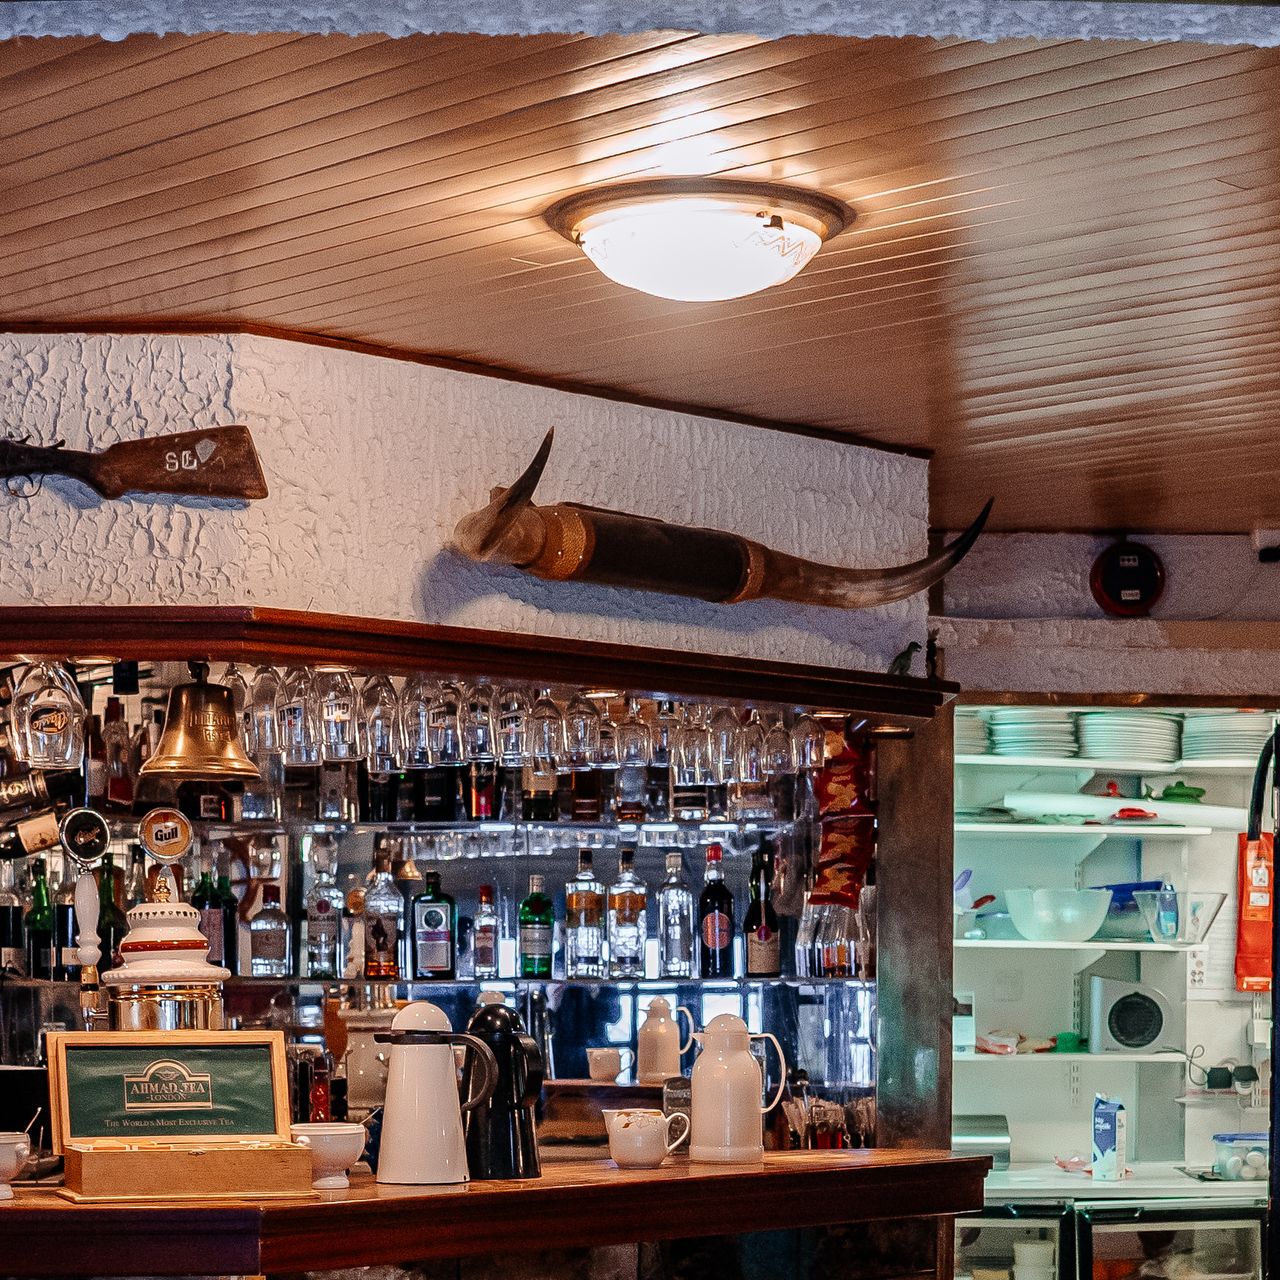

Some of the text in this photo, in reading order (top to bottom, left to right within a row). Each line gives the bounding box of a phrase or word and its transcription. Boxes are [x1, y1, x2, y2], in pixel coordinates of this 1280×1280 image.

[154, 826, 179, 842] Gull
[131, 1082, 206, 1094] AHMAD TEA
